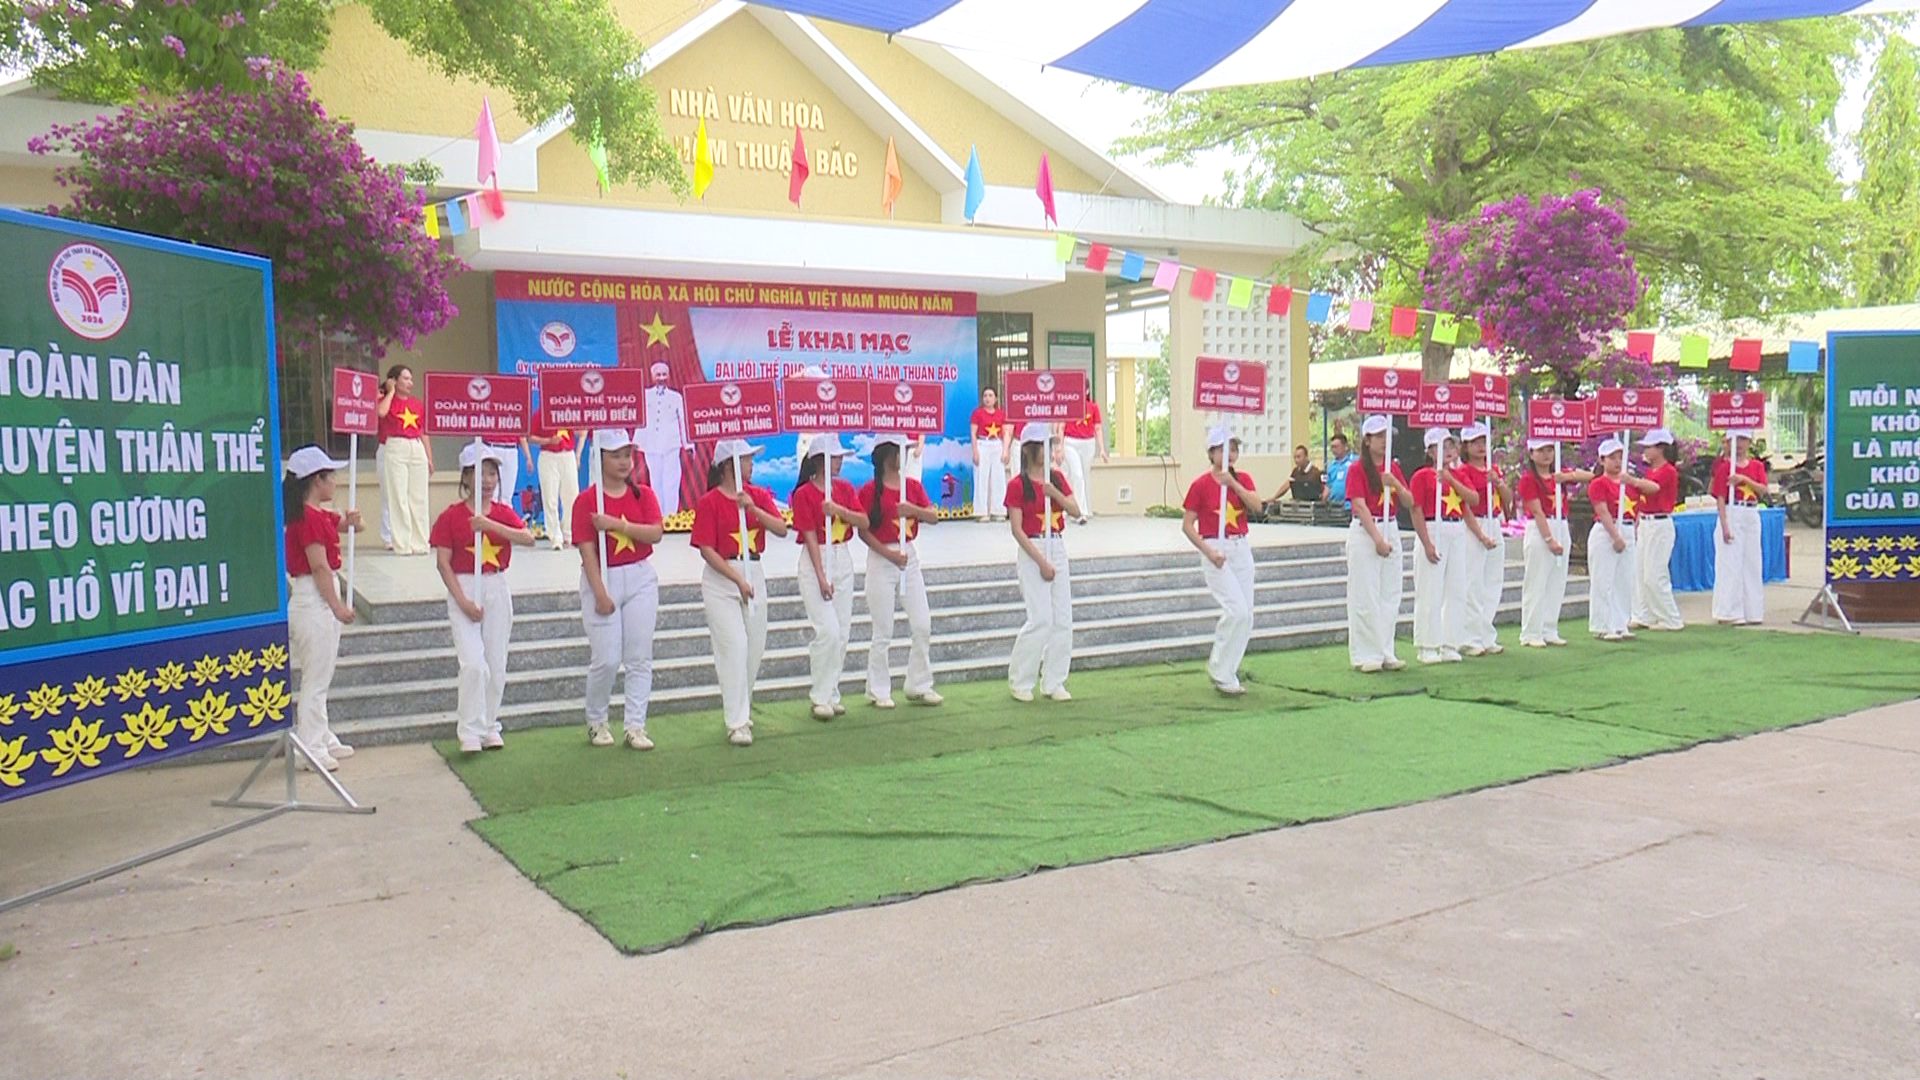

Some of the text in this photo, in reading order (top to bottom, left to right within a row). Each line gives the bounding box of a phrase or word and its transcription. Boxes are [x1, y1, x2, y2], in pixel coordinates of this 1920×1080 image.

[670, 86, 719, 119] NHÀ
[728, 91, 772, 125] VĂN
[736, 140, 807, 176] THUẬ
[816, 141, 857, 177] BẮC
[528, 277, 576, 297] NƯỚC
[581, 280, 626, 302] CỘNG
[668, 283, 689, 302] XÃ
[693, 284, 720, 306] HỘI
[725, 284, 755, 303] CHỦ
[759, 287, 804, 306] NGHĨA
[808, 288, 837, 310] VIỆT
[842, 292, 874, 308] NAM
[878, 293, 919, 311] MUÔN
[922, 293, 953, 311] NĂM
[768, 321, 910, 356] LỄ KHAI MẠC
[0, 342, 181, 405] TOÀN DÂN
[550, 395, 581, 404] ĐOÀN
[608, 394, 636, 403] THAO
[1012, 392, 1037, 401] ĐOÀN
[1056, 393, 1080, 401] THAO
[1850, 383, 1897, 407] MỖI
[434, 400, 467, 410] ĐOÀN
[493, 402, 522, 411] THAO
[694, 408, 722, 418] ĐOÀN
[745, 404, 770, 414] THAO
[790, 402, 817, 411] ĐOÀN
[840, 403, 863, 411] THAO
[915, 406, 937, 414] THAO
[1025, 403, 1068, 416] CÔNG AN
[436, 413, 467, 428] THÔN
[470, 412, 494, 428] DÂN
[551, 408, 580, 423] THÔN
[791, 413, 816, 426] THÔN
[694, 420, 720, 435] THÔN
[0, 417, 265, 484] UYỆN THÂN THỂ
[1853, 438, 1882, 458] LÀ
[1846, 488, 1896, 510] CỦA
[0, 496, 207, 552] HEO GƯƠNG
[48, 559, 101, 624] HỒ
[111, 561, 145, 616] VĨ
[155, 564, 209, 616] ĐẠI
[219, 562, 229, 603] !
